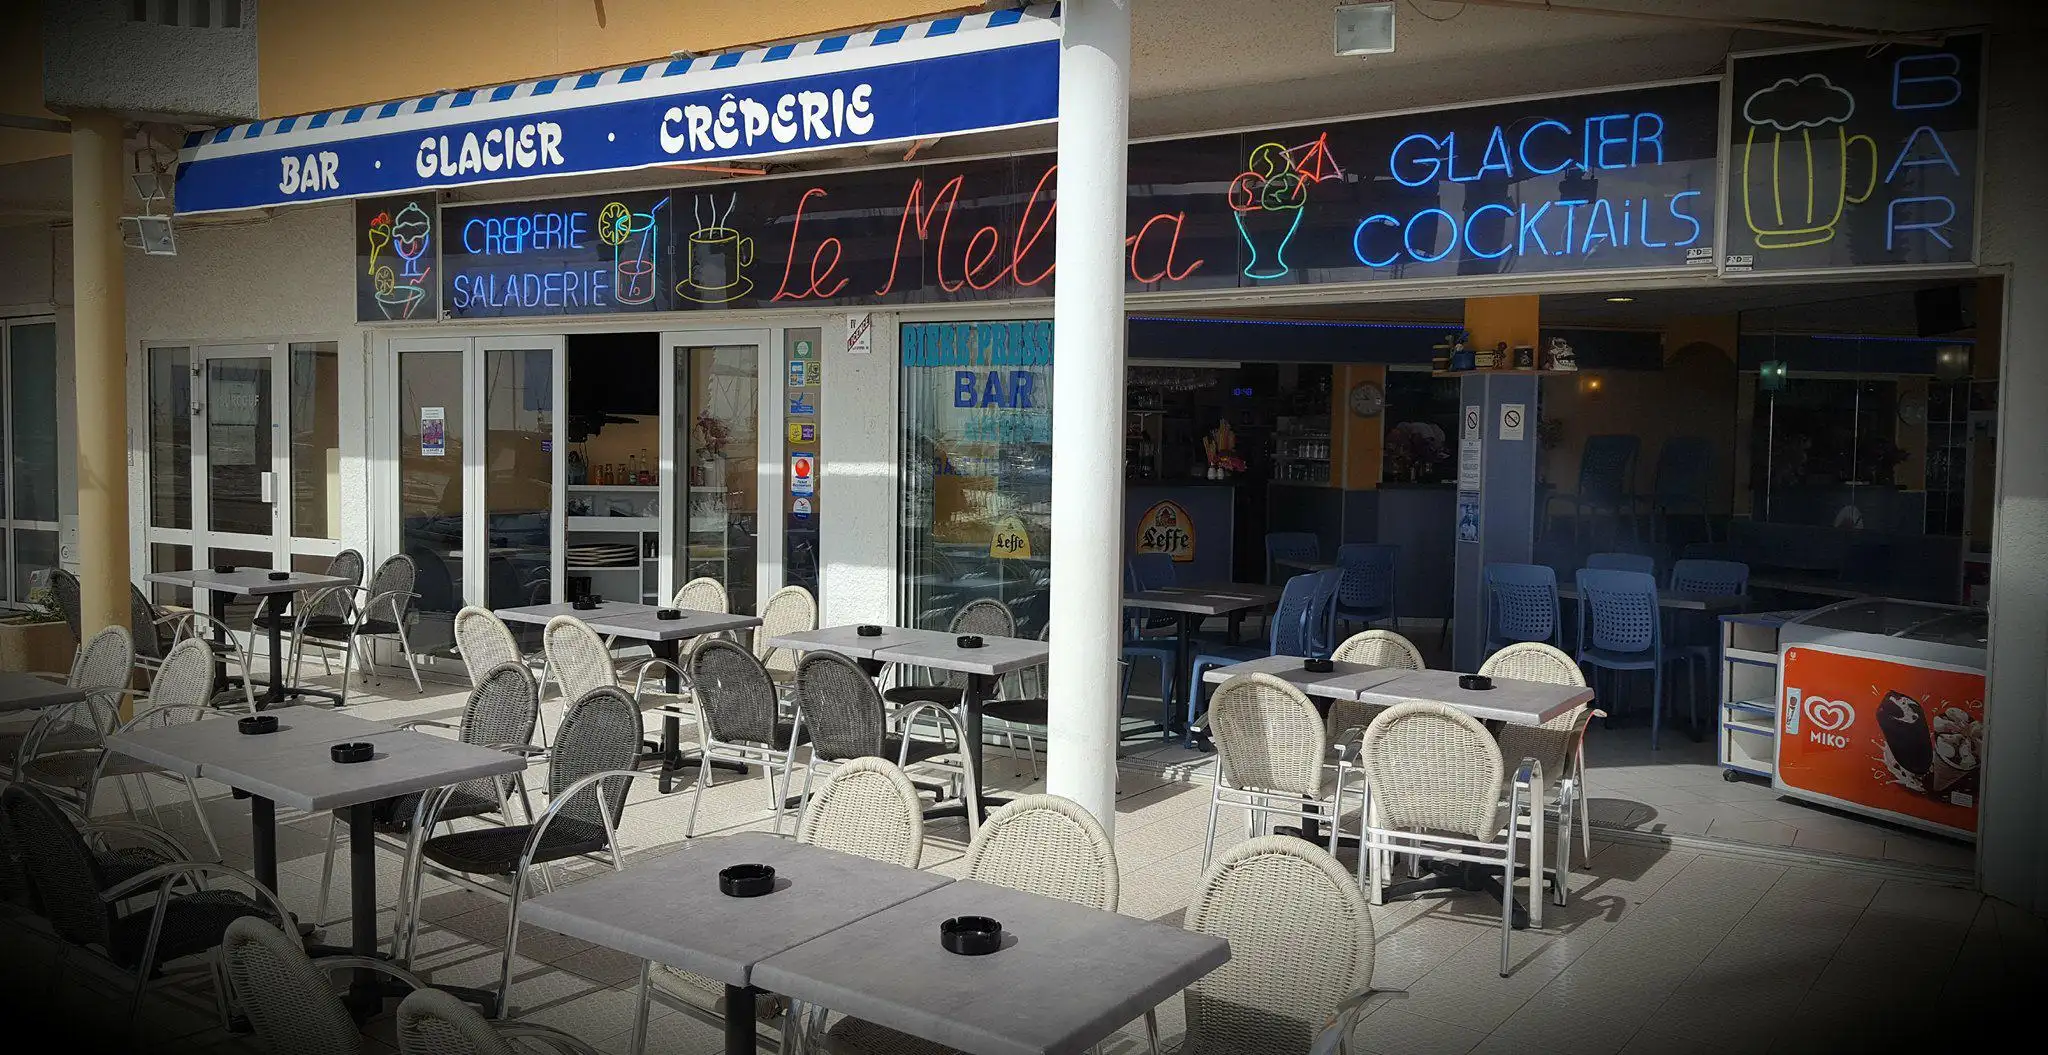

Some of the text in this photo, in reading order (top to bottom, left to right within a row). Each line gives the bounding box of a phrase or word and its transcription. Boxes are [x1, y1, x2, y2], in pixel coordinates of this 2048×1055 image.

[279, 83, 875, 194] BAR GLACIER CRÊPERIE
[1390, 112, 1664, 187] GLACIER
[1885, 53, 1962, 250] BAR
[463, 212, 587, 255] CREPERIE
[770, 164, 1204, 301] Le Mela
[453, 269, 609, 308] SALADERIE
[976, 320, 1054, 366] PRESS
[954, 370, 1033, 408] BAR
[996, 533, 1025, 553] Leffe
[1141, 527, 1190, 552] Leffe
